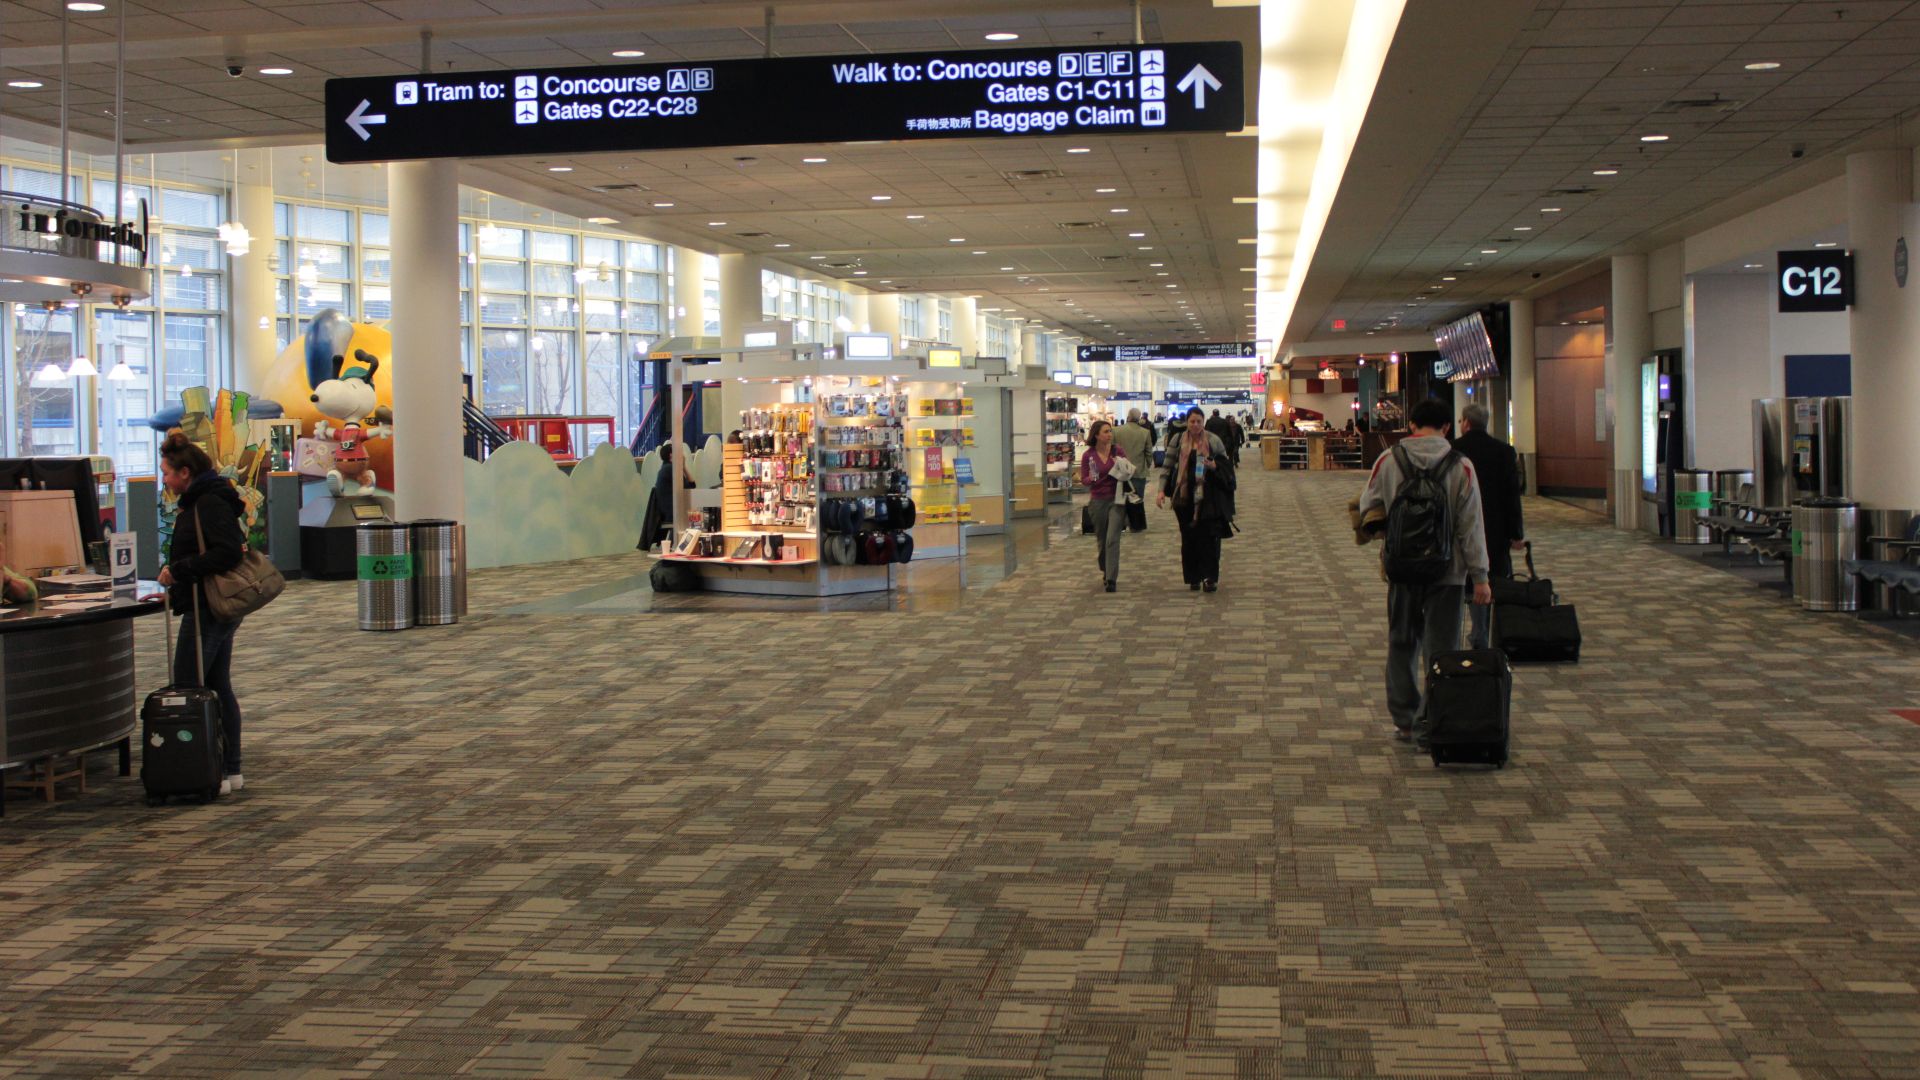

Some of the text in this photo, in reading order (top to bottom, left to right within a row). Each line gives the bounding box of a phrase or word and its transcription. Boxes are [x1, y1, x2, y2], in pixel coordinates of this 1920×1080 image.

[832, 53, 1126, 83] Walk to: Concourse D E F
[422, 81, 505, 102] Tram to:
[543, 70, 710, 96] Concourse A B
[987, 79, 1135, 104] Gates C1-C11
[543, 96, 698, 121] Gates C22-C28
[975, 105, 1135, 133] Baggage Claim
[906, 117, 972, 131] 手荷物受取所
[1781, 265, 1842, 297] C12
